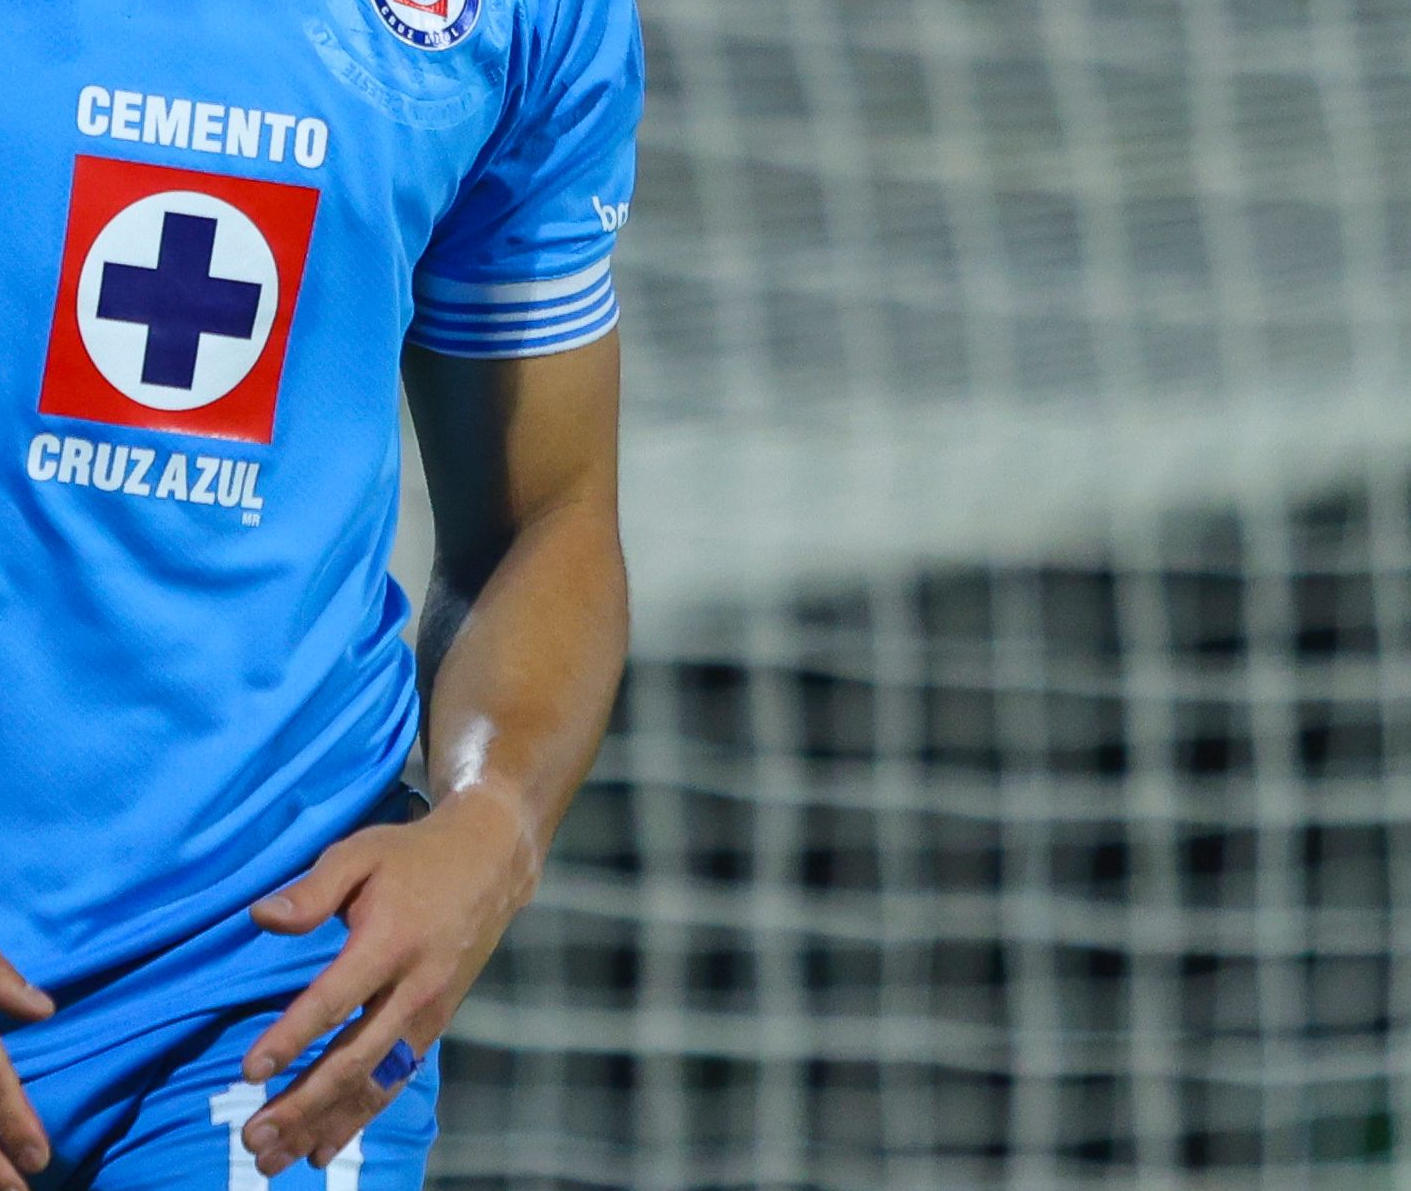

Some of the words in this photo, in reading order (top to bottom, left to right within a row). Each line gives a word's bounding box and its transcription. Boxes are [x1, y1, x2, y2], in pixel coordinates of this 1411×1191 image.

[76, 85, 328, 169] CEMENTO
[26, 433, 157, 497] CRUZ
[155, 452, 264, 510] AZUL
